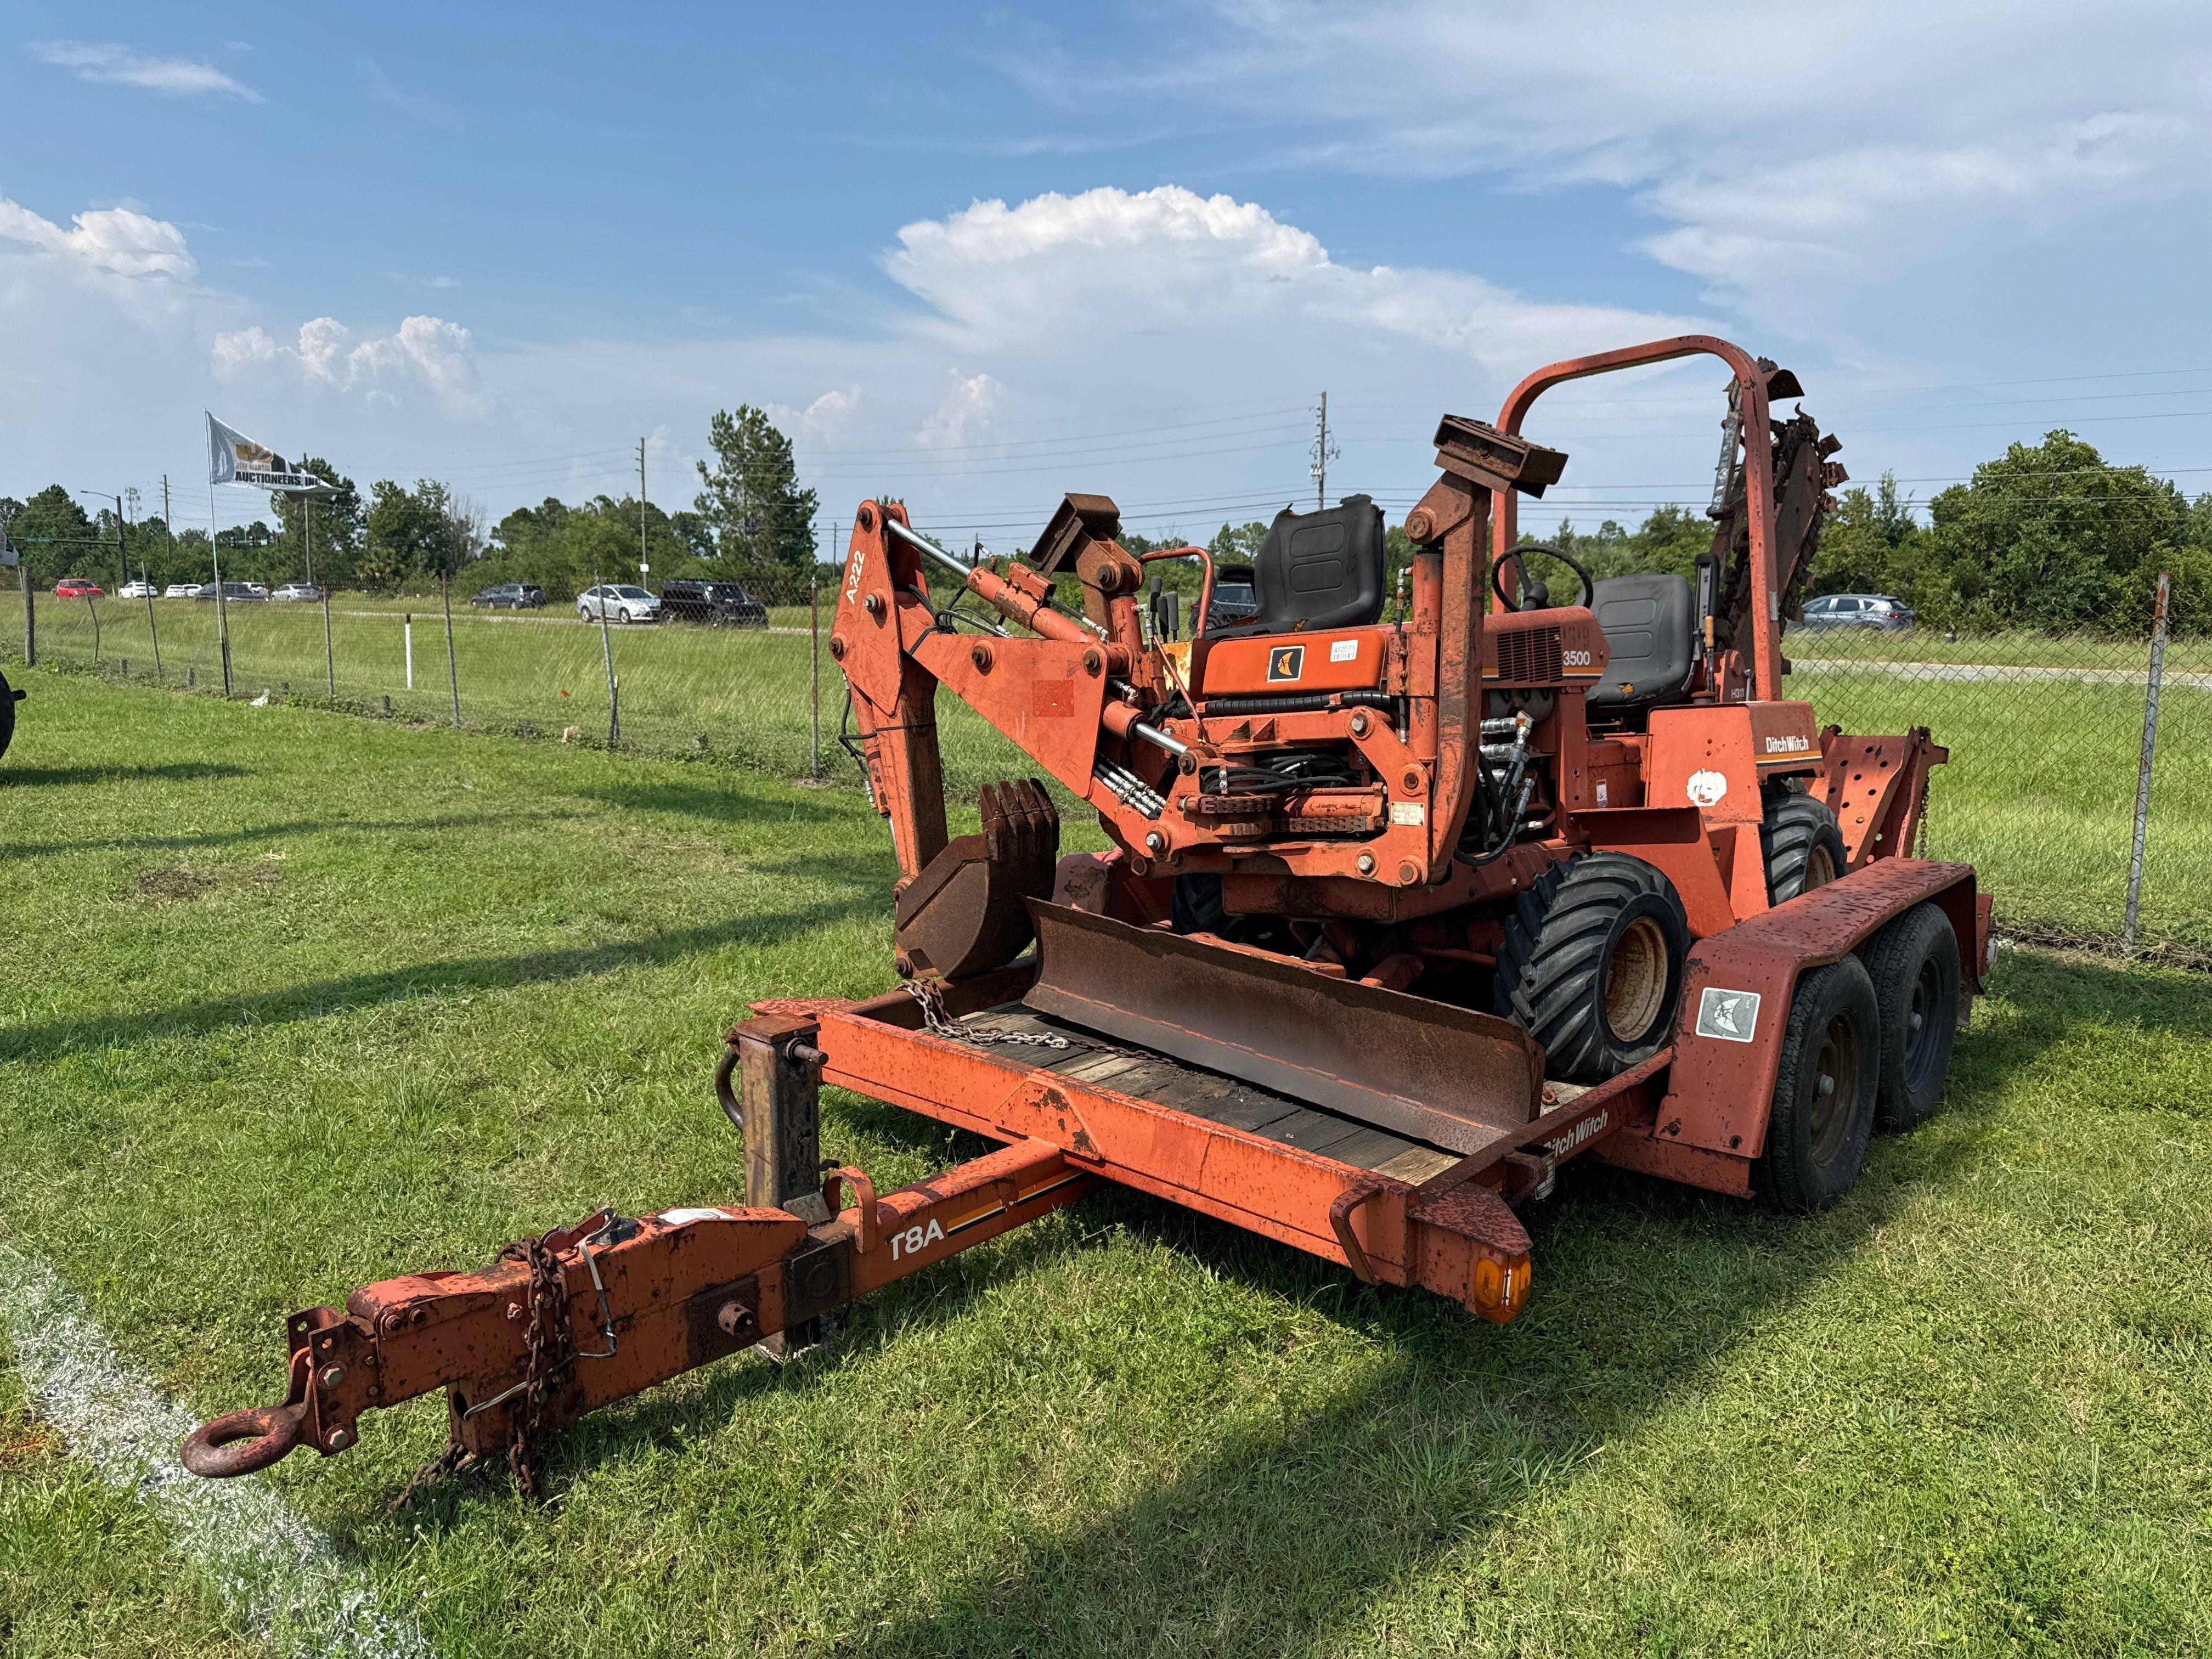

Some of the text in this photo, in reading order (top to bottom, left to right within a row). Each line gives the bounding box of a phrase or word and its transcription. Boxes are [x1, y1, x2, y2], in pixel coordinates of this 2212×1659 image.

[847, 550, 865, 605] A222
[1562, 651, 1590, 666] 3500
[1731, 688, 1745, 699] H311
[890, 1218, 945, 1261] T8A
